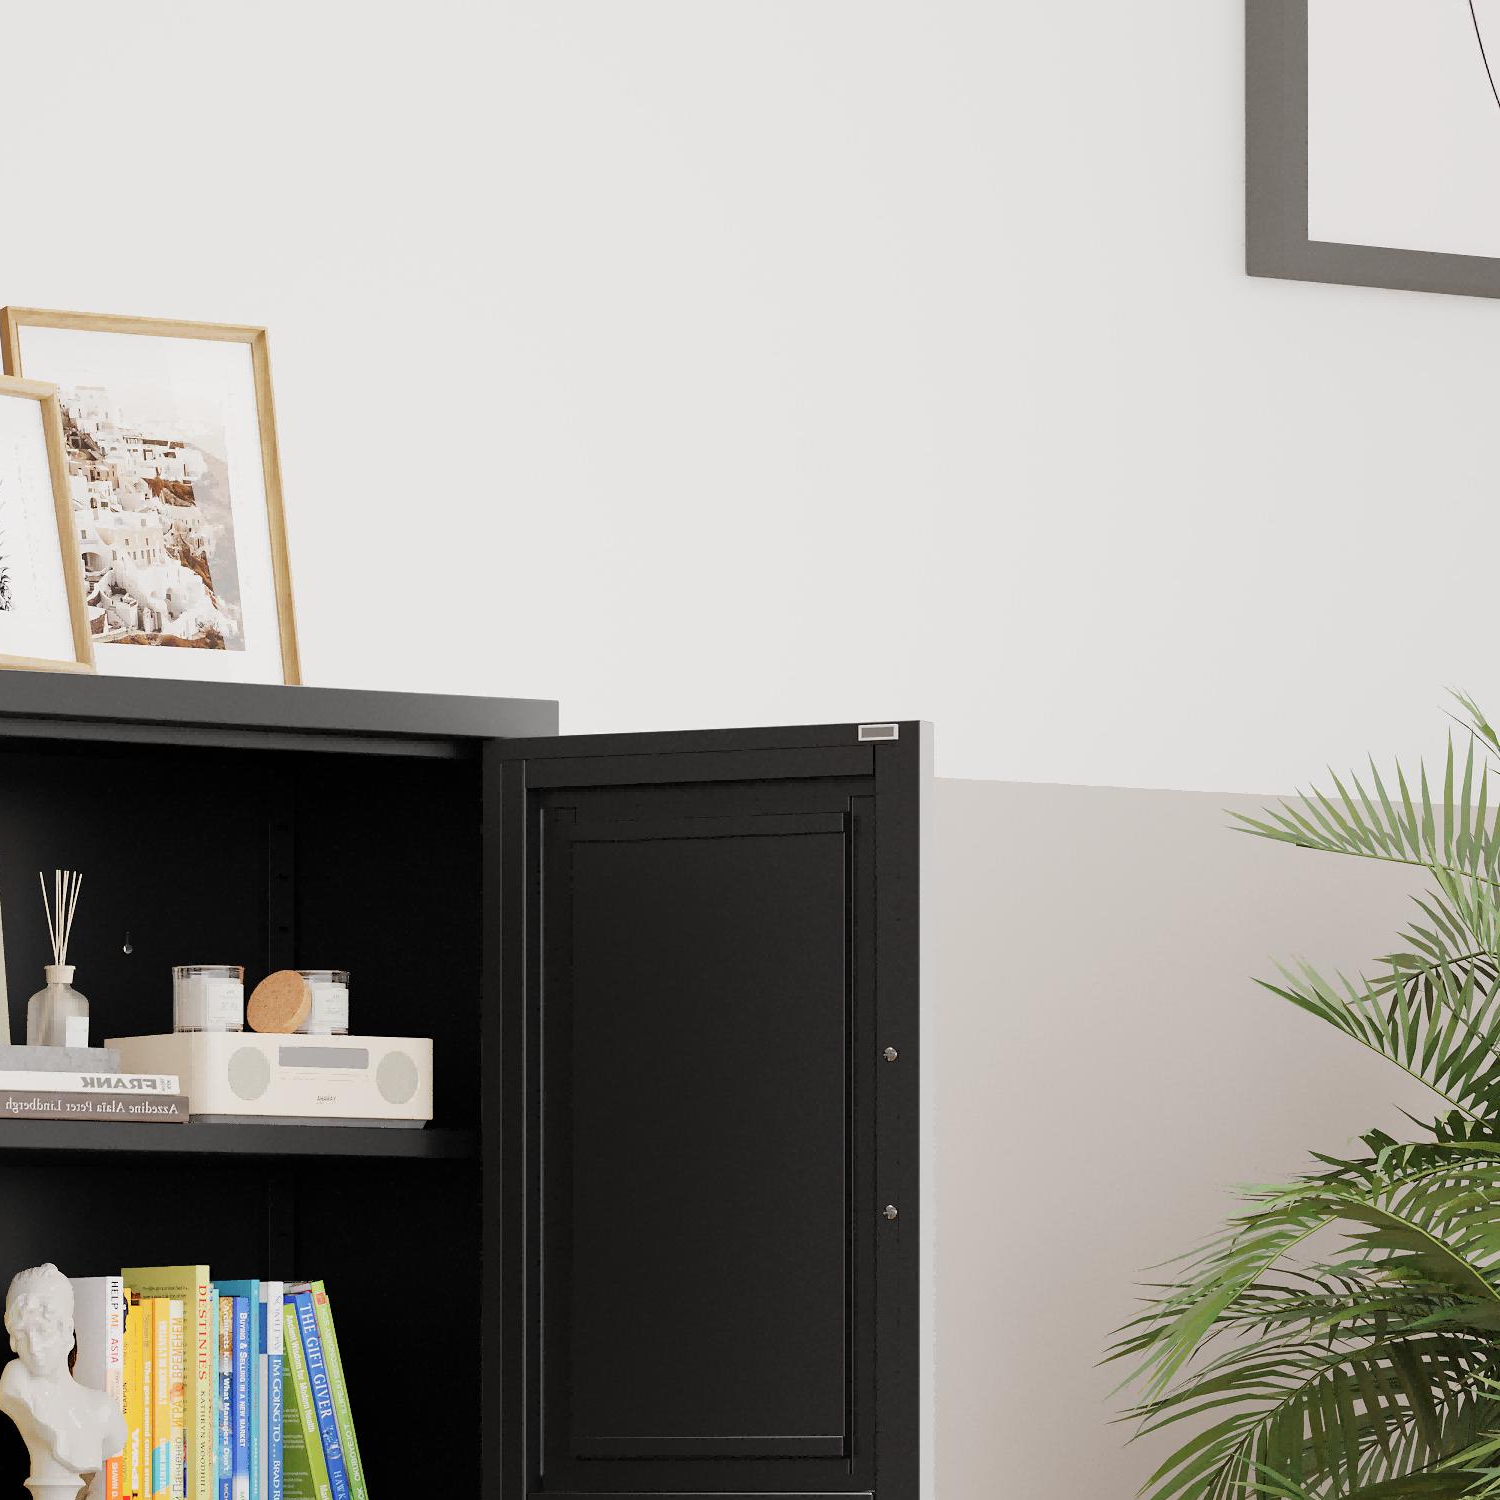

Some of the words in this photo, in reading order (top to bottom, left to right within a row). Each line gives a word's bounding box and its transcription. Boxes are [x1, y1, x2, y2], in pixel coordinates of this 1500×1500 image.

[110, 1281, 120, 1310] HELP
[198, 1284, 208, 1381] DESTINIES
[222, 1304, 231, 1350] Architects
[299, 1302, 317, 1335] THE
[272, 1359, 282, 1377] I'M
[306, 1336, 323, 1370] GIFT
[222, 1378, 231, 1400] What
[272, 1378, 282, 1421] GOING
[313, 1373, 333, 1420] GIVER
[221, 1402, 231, 1446] Managers
[111, 1462, 120, 1489] SHAWN
[273, 1460, 281, 1489] BRAD
